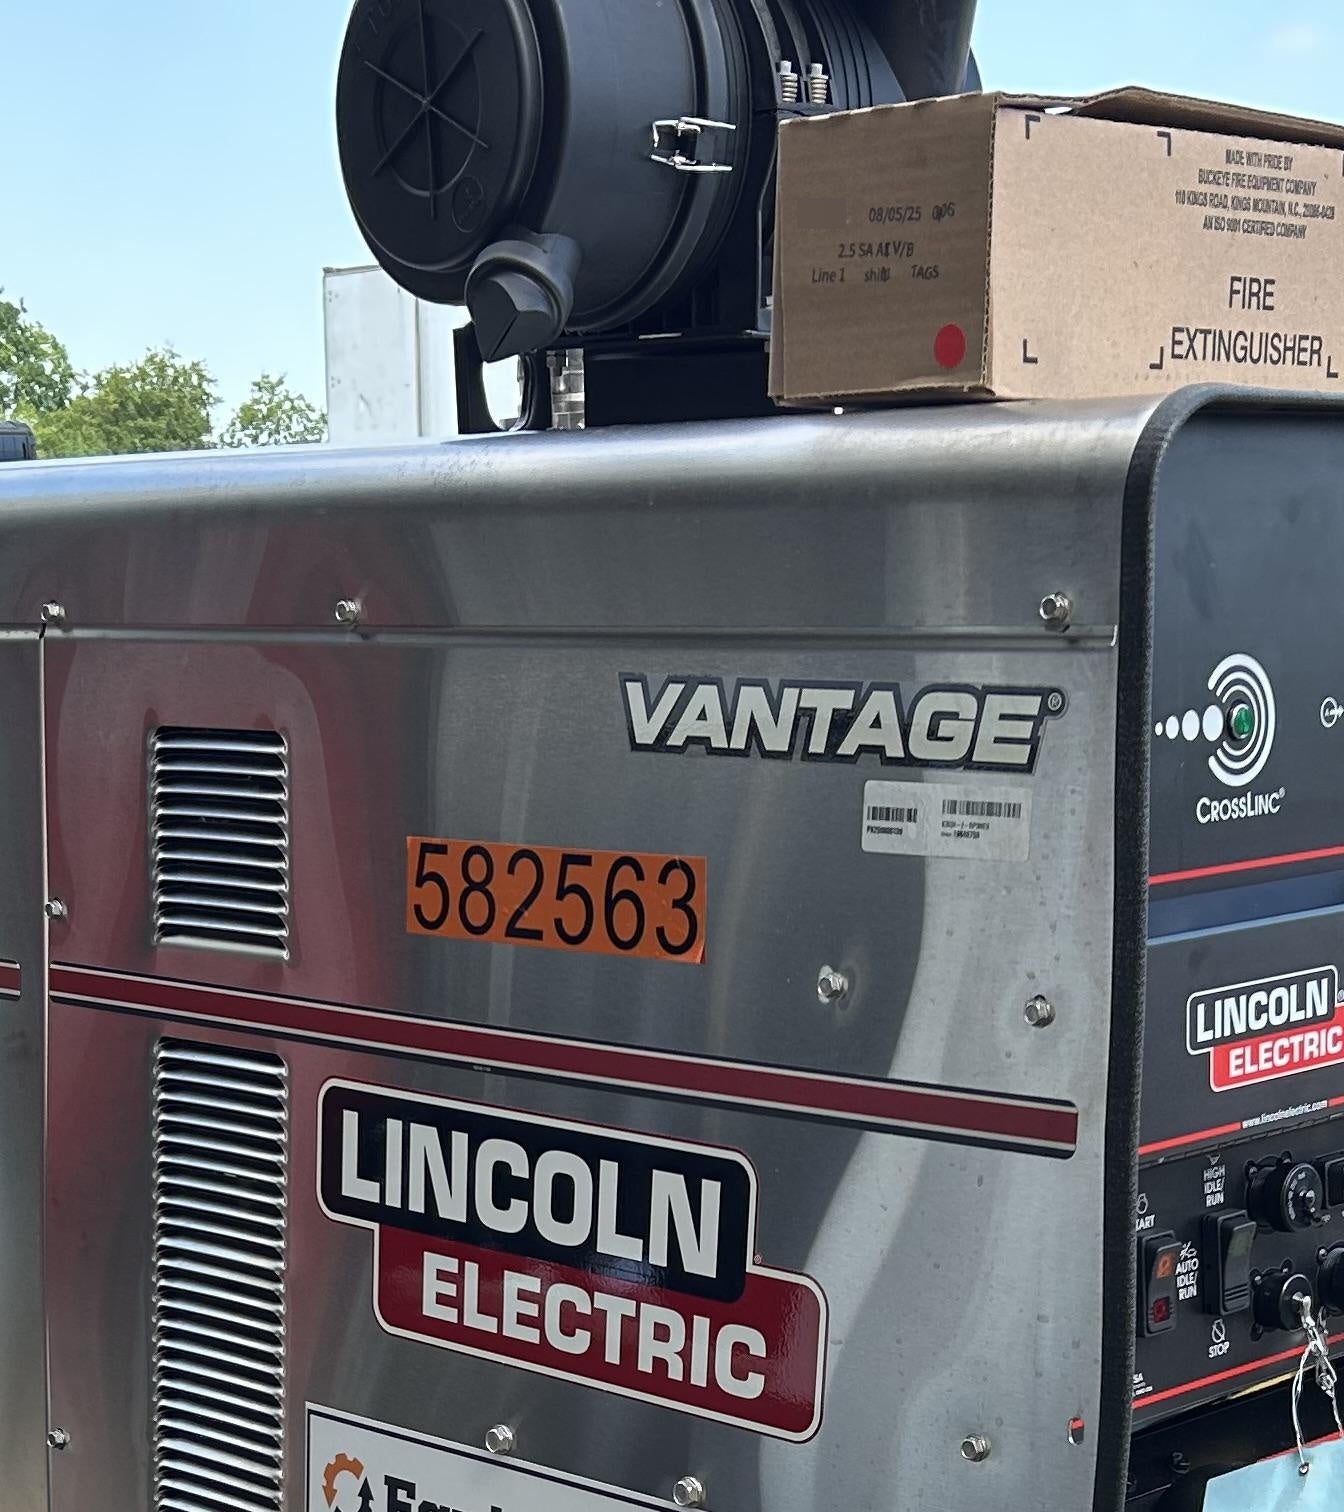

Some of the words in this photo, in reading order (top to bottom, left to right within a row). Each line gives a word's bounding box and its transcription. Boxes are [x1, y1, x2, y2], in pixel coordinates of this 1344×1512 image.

[1198, 168, 1230, 187] BUCKEYE
[1231, 172, 1247, 189] FIRE
[1247, 174, 1285, 193] EQUIPMENT
[1285, 178, 1317, 196] COMPANY
[812, 268, 836, 283] Line
[1229, 276, 1275, 312] FIRE
[1170, 327, 1323, 368] EXTINGUISHER
[623, 680, 1044, 766] VANTAGE
[413, 842, 699, 956] 582563
[1196, 977, 1329, 1043] LINCOLN
[1228, 1025, 1344, 1079] ELECTRIC
[1203, 1164, 1226, 1181] HIGH
[341, 1108, 722, 1280] LINCOLN
[1206, 1192, 1224, 1208] RUN
[1175, 1258, 1198, 1275] AUTO
[1178, 1284, 1198, 1300] RUN
[422, 1250, 767, 1400] ELECTRIC
[1208, 1341, 1230, 1359] STOP
